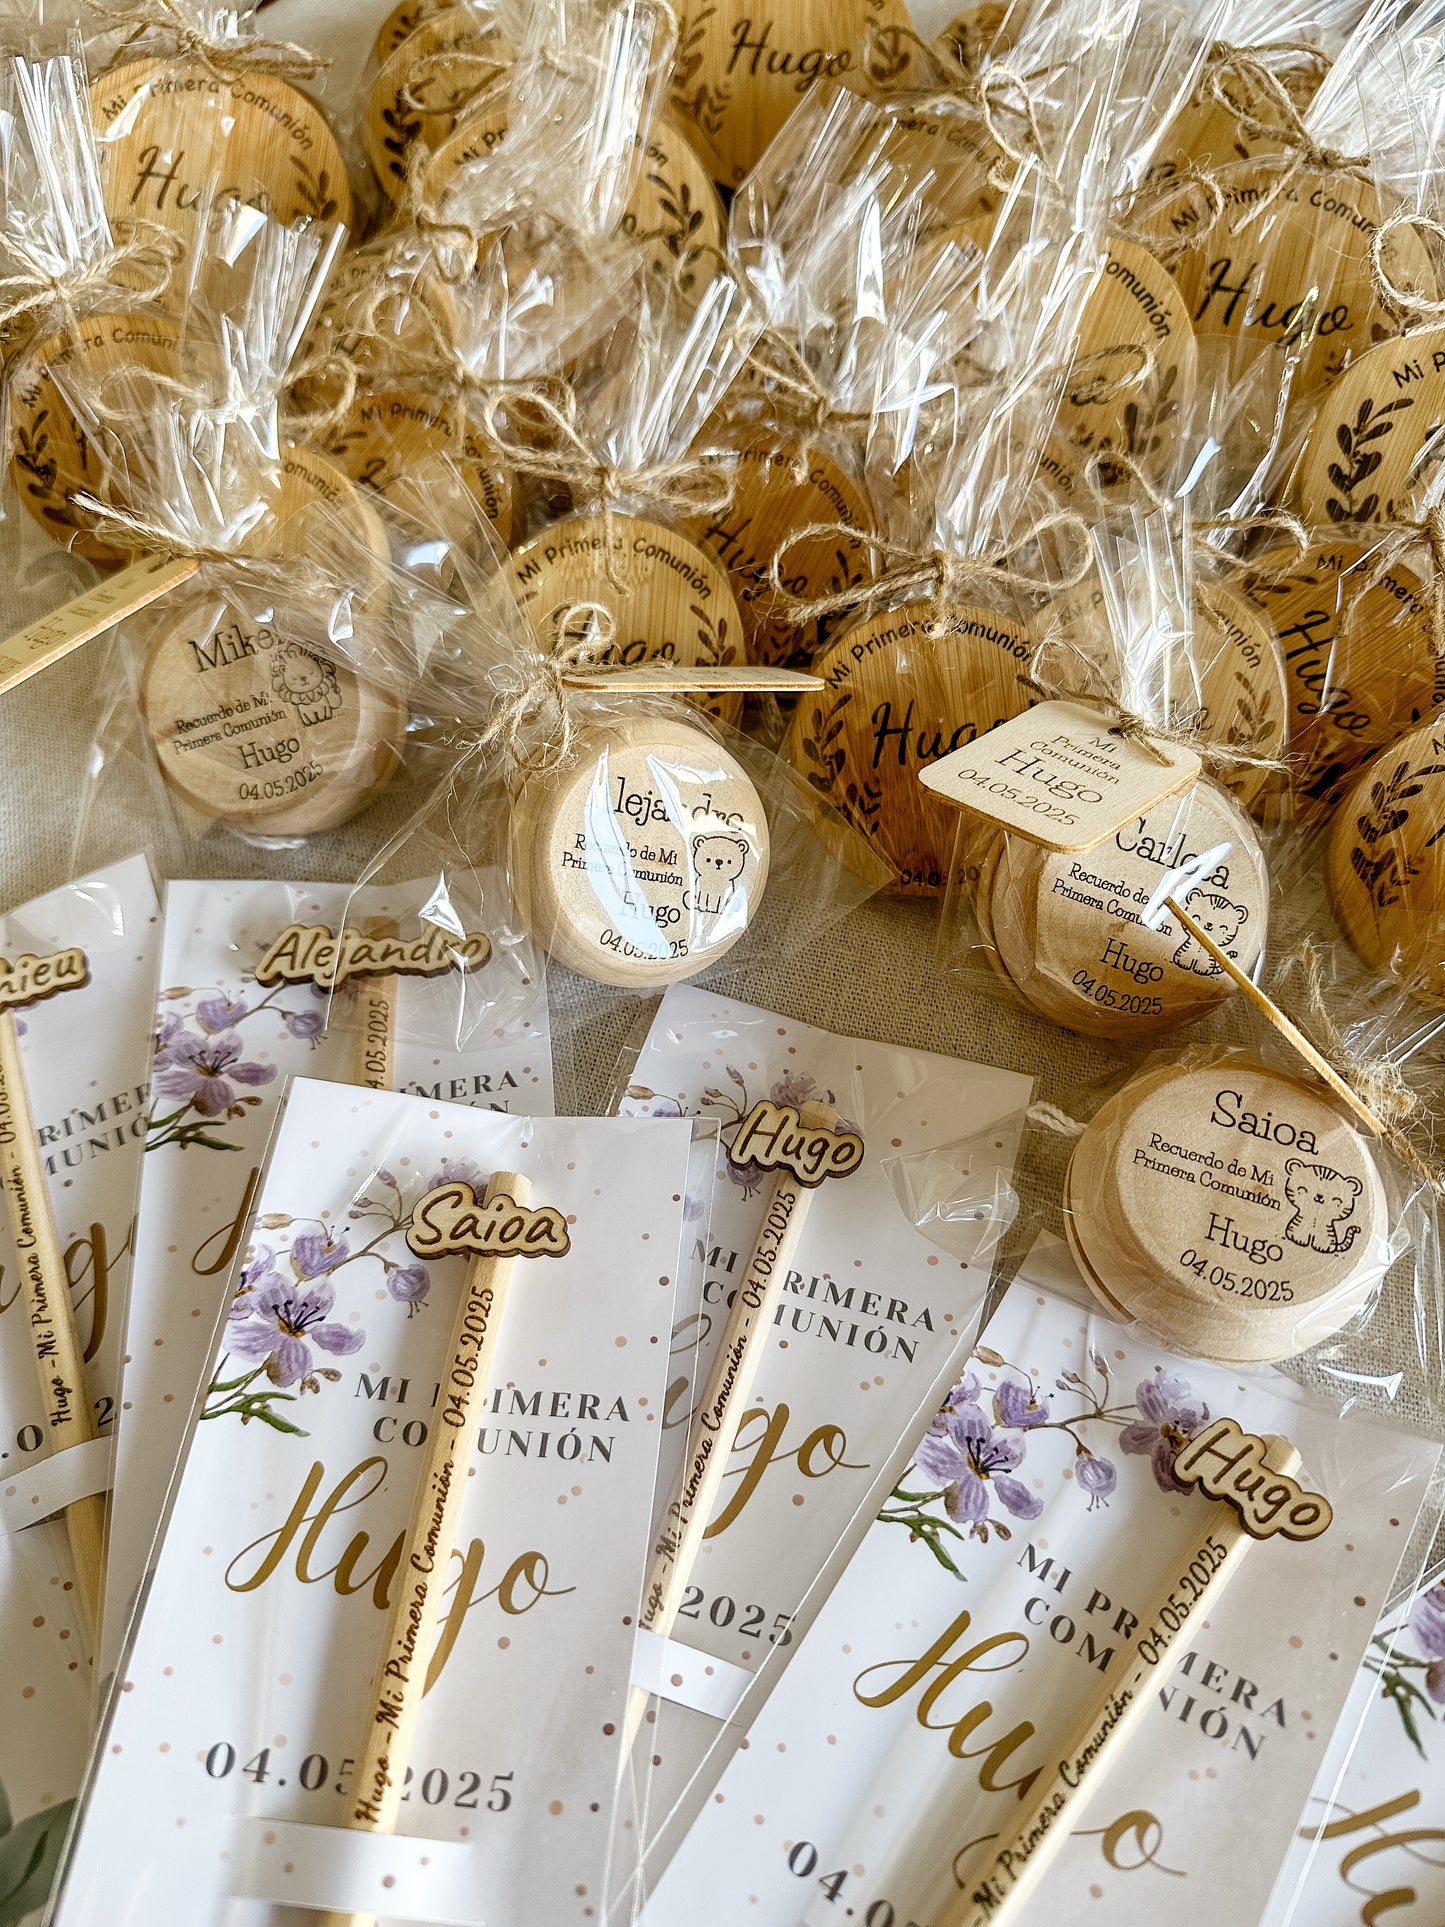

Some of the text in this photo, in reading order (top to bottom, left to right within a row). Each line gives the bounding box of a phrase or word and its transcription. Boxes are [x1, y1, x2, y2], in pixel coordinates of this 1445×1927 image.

[727, 19, 856, 88] Hugo
[103, 76, 313, 151] Mi rimera Comunión
[1170, 206, 1199, 232] Mi
[1310, 190, 1381, 242] Comun
[1104, 254, 1171, 340] omunión
[1194, 258, 1354, 347] Hugo
[1392, 359, 1424, 389] Mi
[516, 559, 542, 585] Mi
[633, 537, 713, 601] Comunión
[1316, 553, 1344, 572] Mi
[827, 660, 852, 690] Mi
[849, 617, 935, 664] Primera
[1278, 609, 1371, 738] Hugo
[173, 709, 287, 755] Primera Comunión
[175, 690, 273, 735] Recuerdo de Mi
[236, 737, 301, 770] Hugo
[1029, 741, 1120, 785] Comunión
[1050, 735, 1122, 771] Primera
[1088, 737, 1118, 754] Mi
[239, 760, 324, 801] 04.05.2025
[957, 769, 1081, 826] 04.05.2025
[994, 748, 1103, 803] Hugo
[639, 845, 656, 861] de
[658, 847, 678, 866] Mi
[1115, 817, 1231, 890] Carloa
[1051, 878, 1173, 937] Primera Comuón
[1068, 861, 1150, 906] Recuerdo de
[263, 927, 483, 979] Alejandro
[1099, 937, 1165, 985] Hugo
[1072, 969, 1163, 1016] 04.05.2025
[365, 999, 391, 1089] 4.05.2025
[402, 1069, 520, 1102] MERA
[738, 1108, 856, 1175] Hugo
[1210, 1089, 1319, 1156] Saioa
[1132, 1148, 1281, 1211] Primera Comunión
[1148, 1132, 1275, 1187] Recuerdo de Mi
[10, 1164, 37, 1250] Comunión
[415, 1190, 559, 1245] Saioa
[1204, 1211, 1284, 1265] Hugo
[31, 1252, 53, 1328] Primera
[689, 1238, 936, 1333] MI RIMERA
[1179, 1248, 1295, 1302] 04.05.2025
[38, 1331, 61, 1360] Mi
[442, 1285, 494, 1429] 04.05.2025
[667, 1438, 714, 1525] Primera
[700, 1333, 749, 1432] Comunión
[741, 1188, 797, 1310] 04.05.2025
[50, 1374, 73, 1427] Hugo
[354, 1373, 631, 1423] MI IMERA
[373, 1416, 617, 1464] COUNIÓN
[1184, 1426, 1322, 1526] Hugo
[410, 1456, 456, 1574] Comunión
[385, 1582, 428, 1688] Primera
[1016, 1542, 1289, 1729] MI PRERA
[375, 1687, 405, 1729] Mi
[1024, 1596, 1267, 1762] COMNIÓN
[996, 1794, 1065, 1881] Primera
[1057, 1690, 1134, 1789] Comunión
[1137, 1536, 1229, 1666] 04.05.2025
[205, 1741, 515, 1813] 04.05025
[853, 1609, 1188, 1890] Huo
[355, 1755, 389, 1824] Hugo
